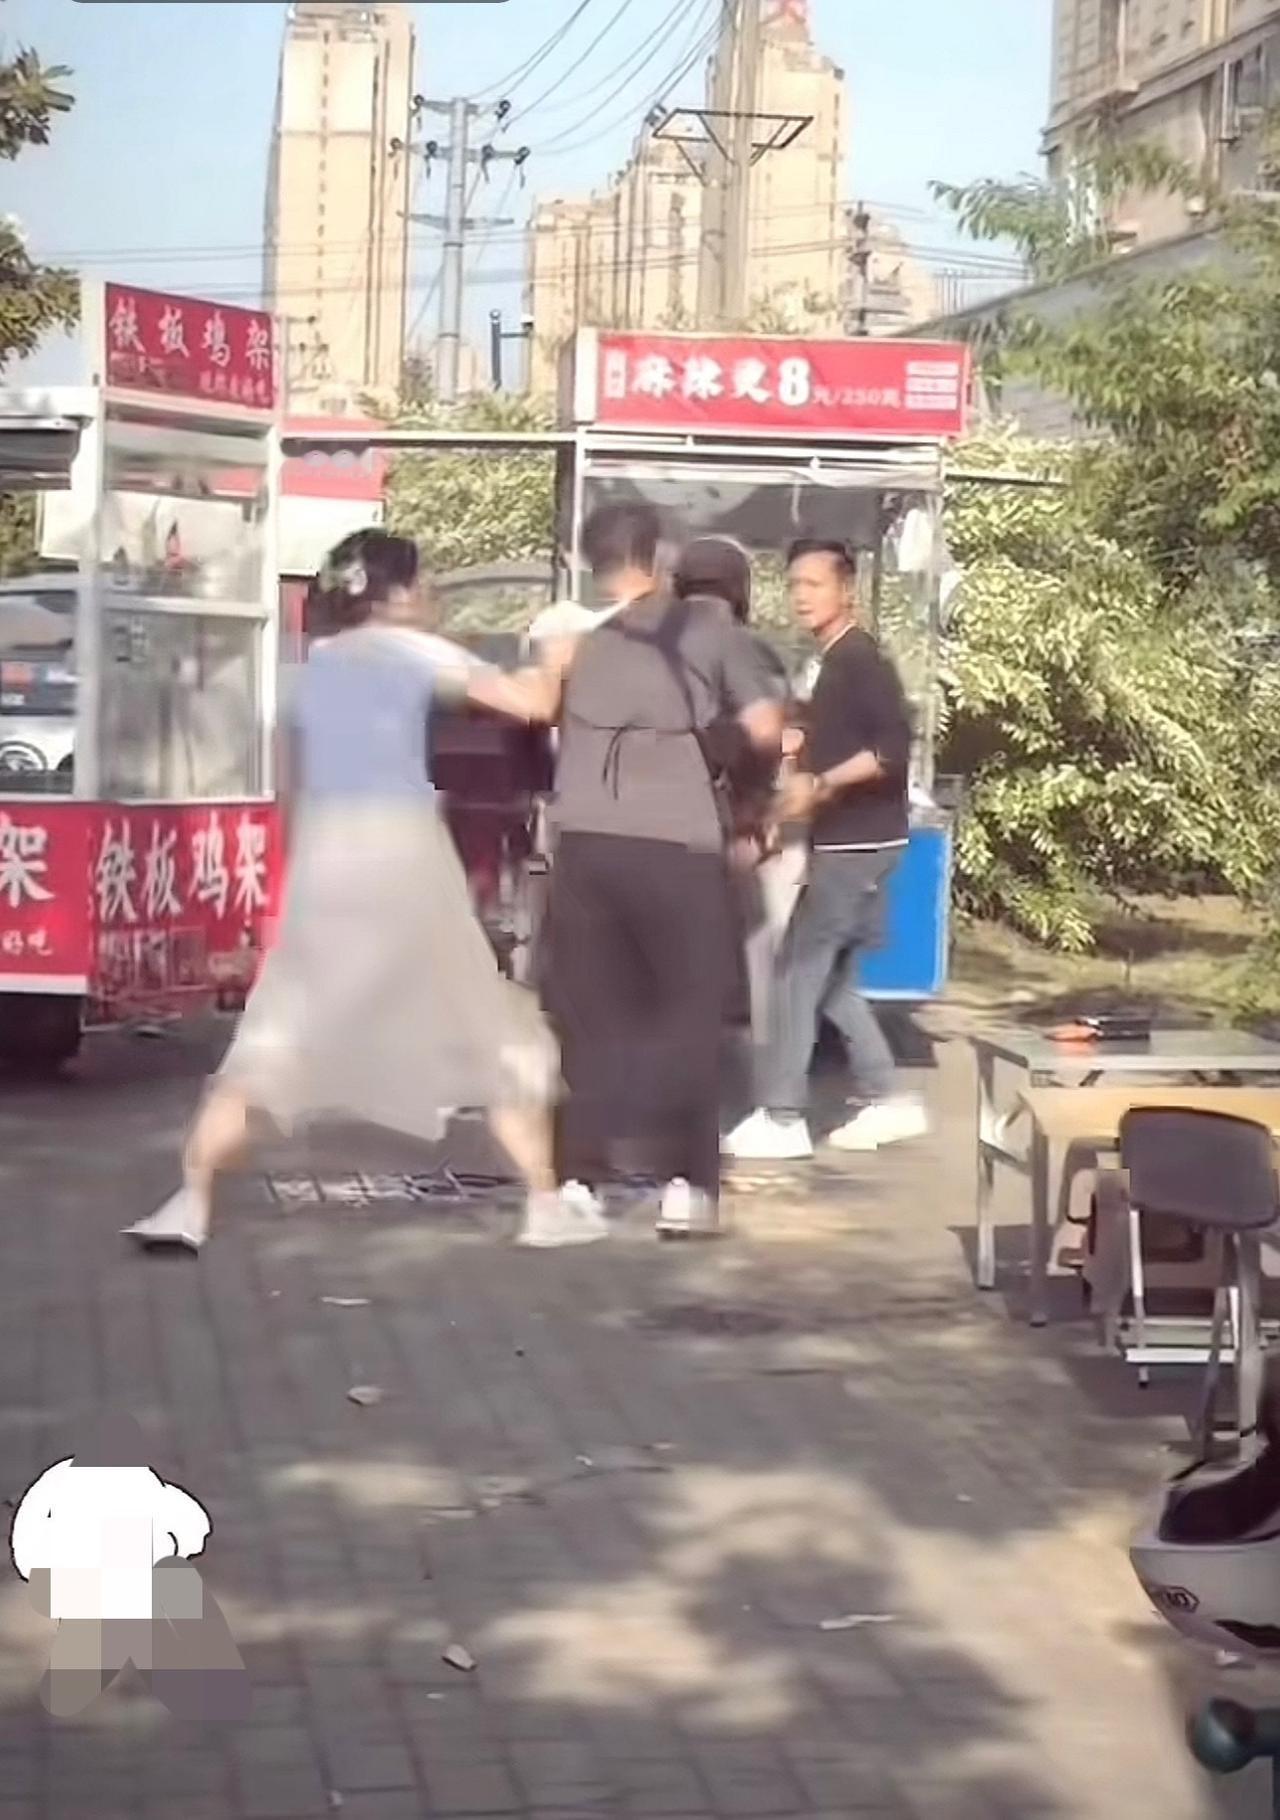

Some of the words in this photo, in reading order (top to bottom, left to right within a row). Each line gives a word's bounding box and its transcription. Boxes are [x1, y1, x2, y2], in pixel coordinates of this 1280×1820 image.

[110, 297, 270, 371] 铁板鸡架
[97, 809, 268, 924] 铁板鸡架
